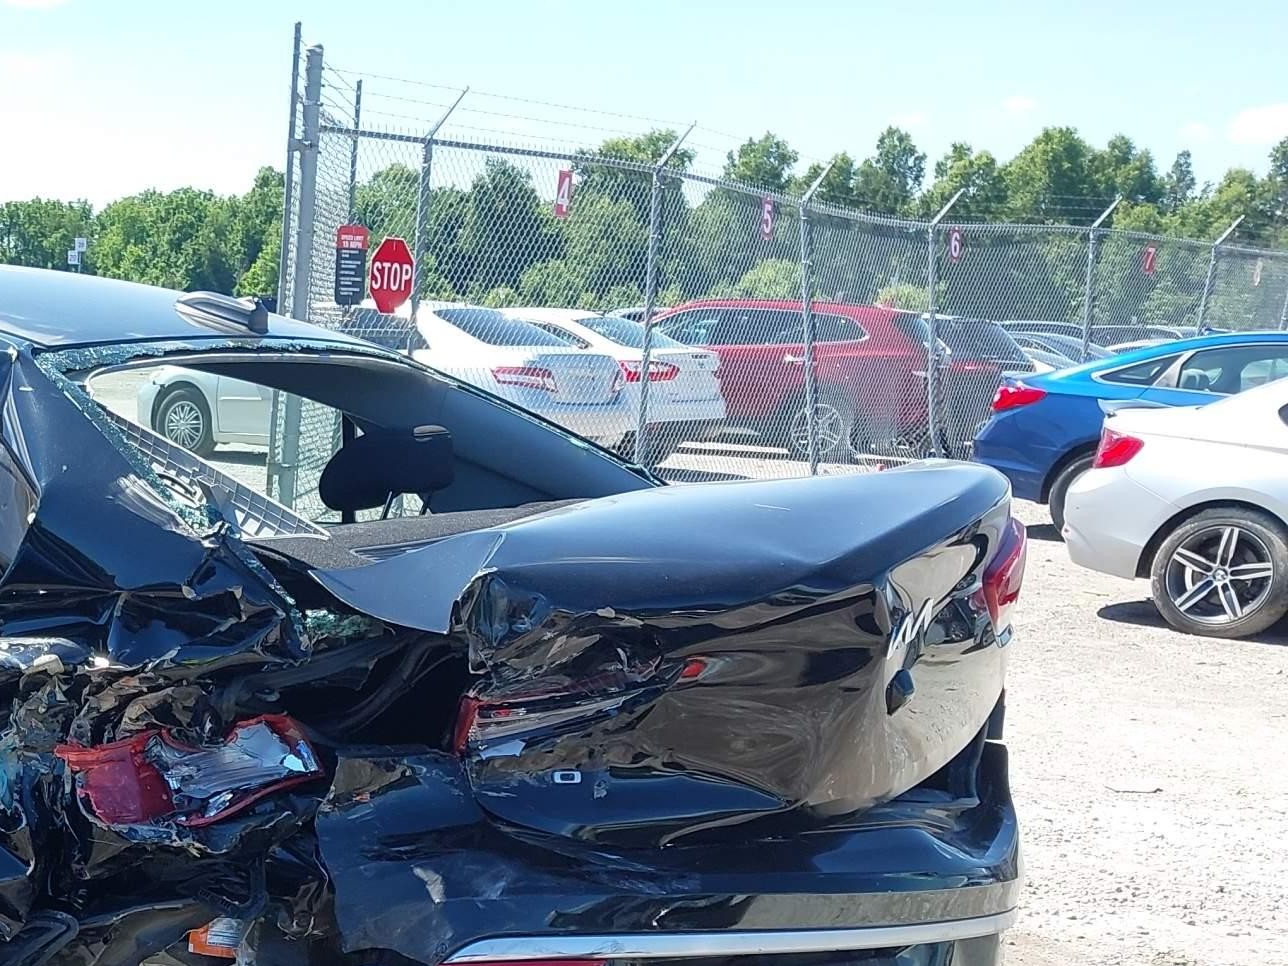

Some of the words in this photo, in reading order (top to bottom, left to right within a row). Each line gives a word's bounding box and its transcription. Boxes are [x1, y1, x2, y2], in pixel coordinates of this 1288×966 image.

[557, 177, 570, 212] 4
[764, 203, 772, 234] 5
[952, 232, 960, 258] 6
[1146, 247, 1156, 270] 7
[372, 261, 412, 292] STOP
